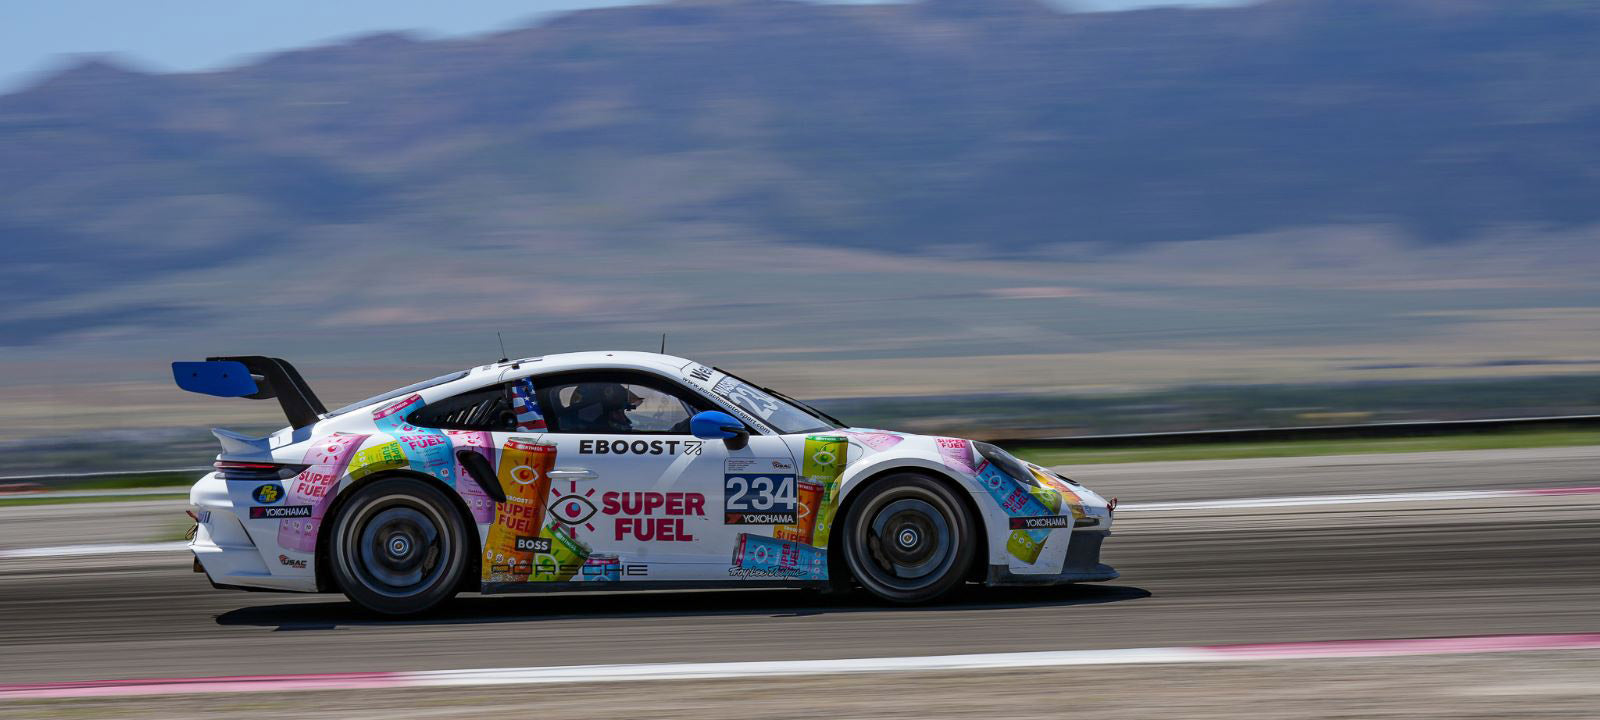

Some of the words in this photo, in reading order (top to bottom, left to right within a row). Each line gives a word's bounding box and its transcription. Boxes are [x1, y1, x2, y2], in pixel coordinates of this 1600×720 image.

[408, 437, 445, 450] FUEL
[579, 439, 681, 456] EBOOST
[299, 471, 337, 487] SUPER
[297, 482, 327, 498] FUEL
[726, 476, 797, 511] 234
[601, 491, 706, 517] SUPER
[265, 507, 310, 517] YOKOHAMA
[743, 514, 794, 524] YOKOHAMA
[499, 513, 530, 533] FUEL
[1025, 518, 1067, 527] YOKOHAMA
[614, 518, 694, 542] FUEL
[517, 538, 549, 550] BOSS
[281, 559, 307, 567] USAC
[491, 564, 649, 577] PORSCHE
